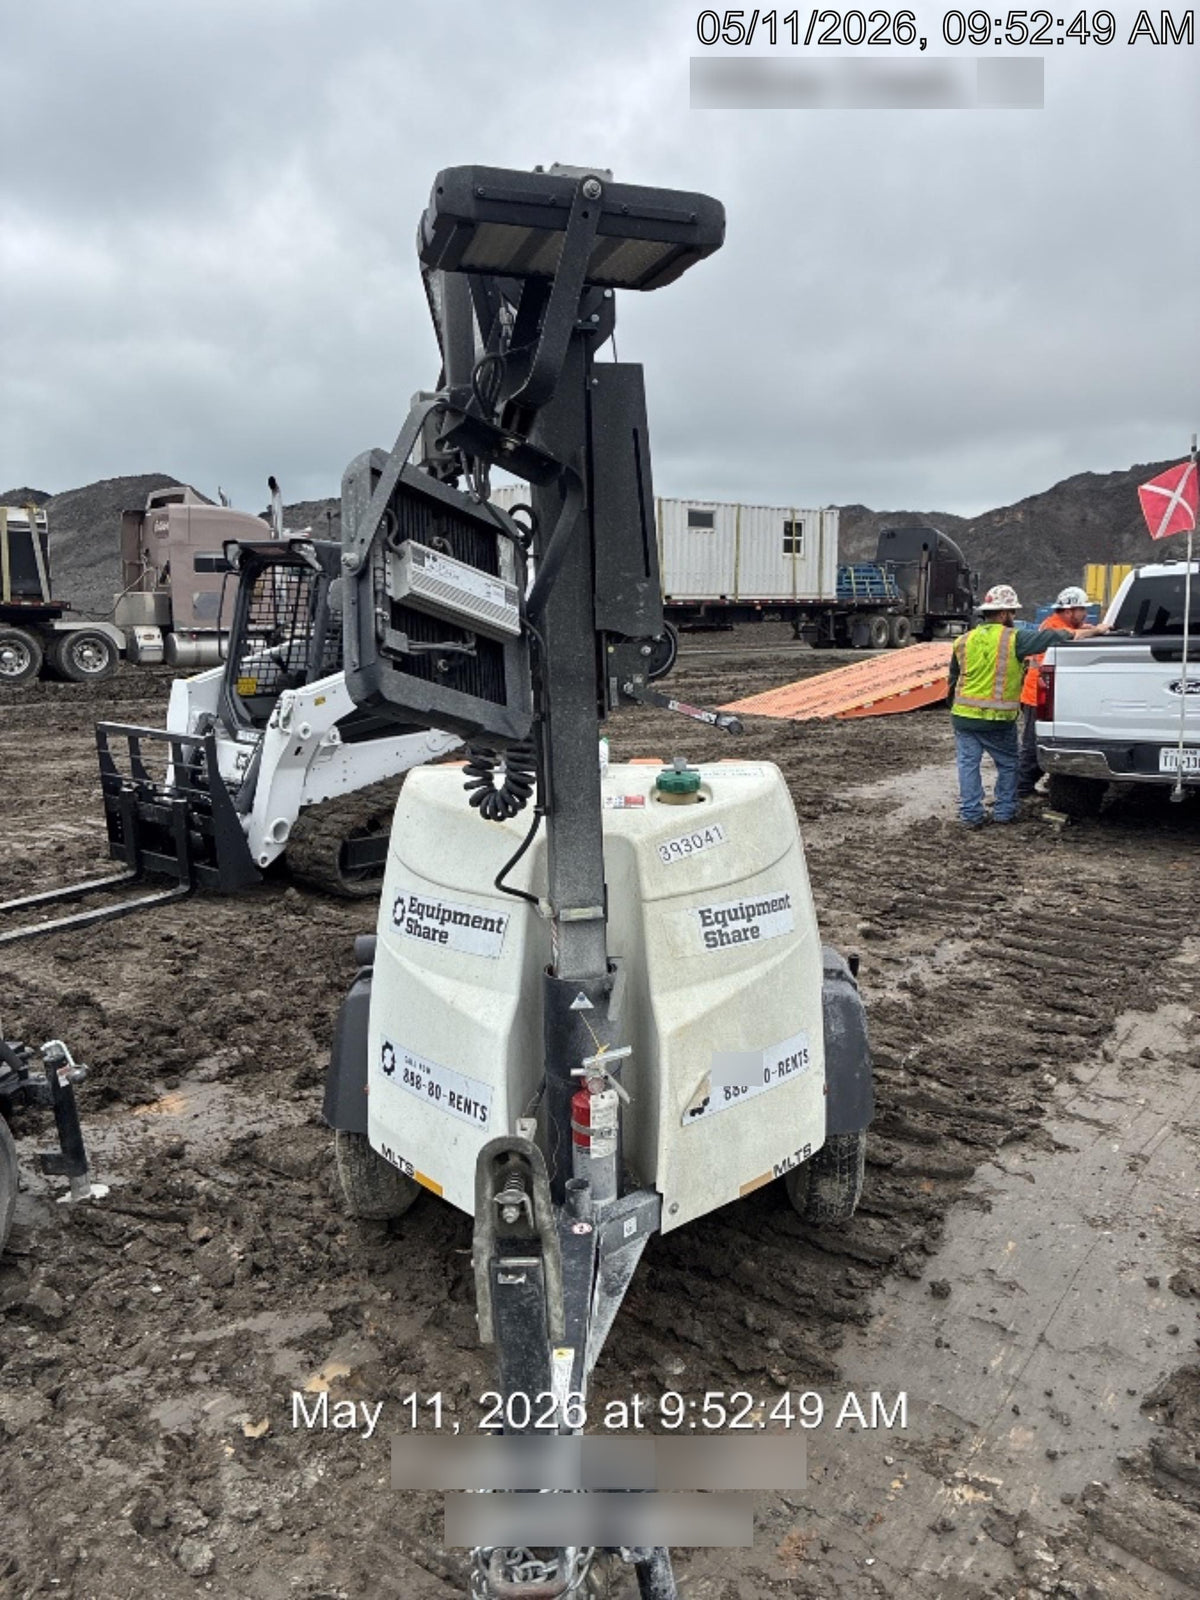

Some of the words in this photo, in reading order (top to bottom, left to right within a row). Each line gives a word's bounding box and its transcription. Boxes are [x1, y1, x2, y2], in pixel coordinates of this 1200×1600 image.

[659, 825, 723, 861] 393041
[408, 896, 505, 934] Equipment
[698, 893, 792, 928] Equipment
[405, 917, 449, 944] Share
[703, 925, 760, 949] Share
